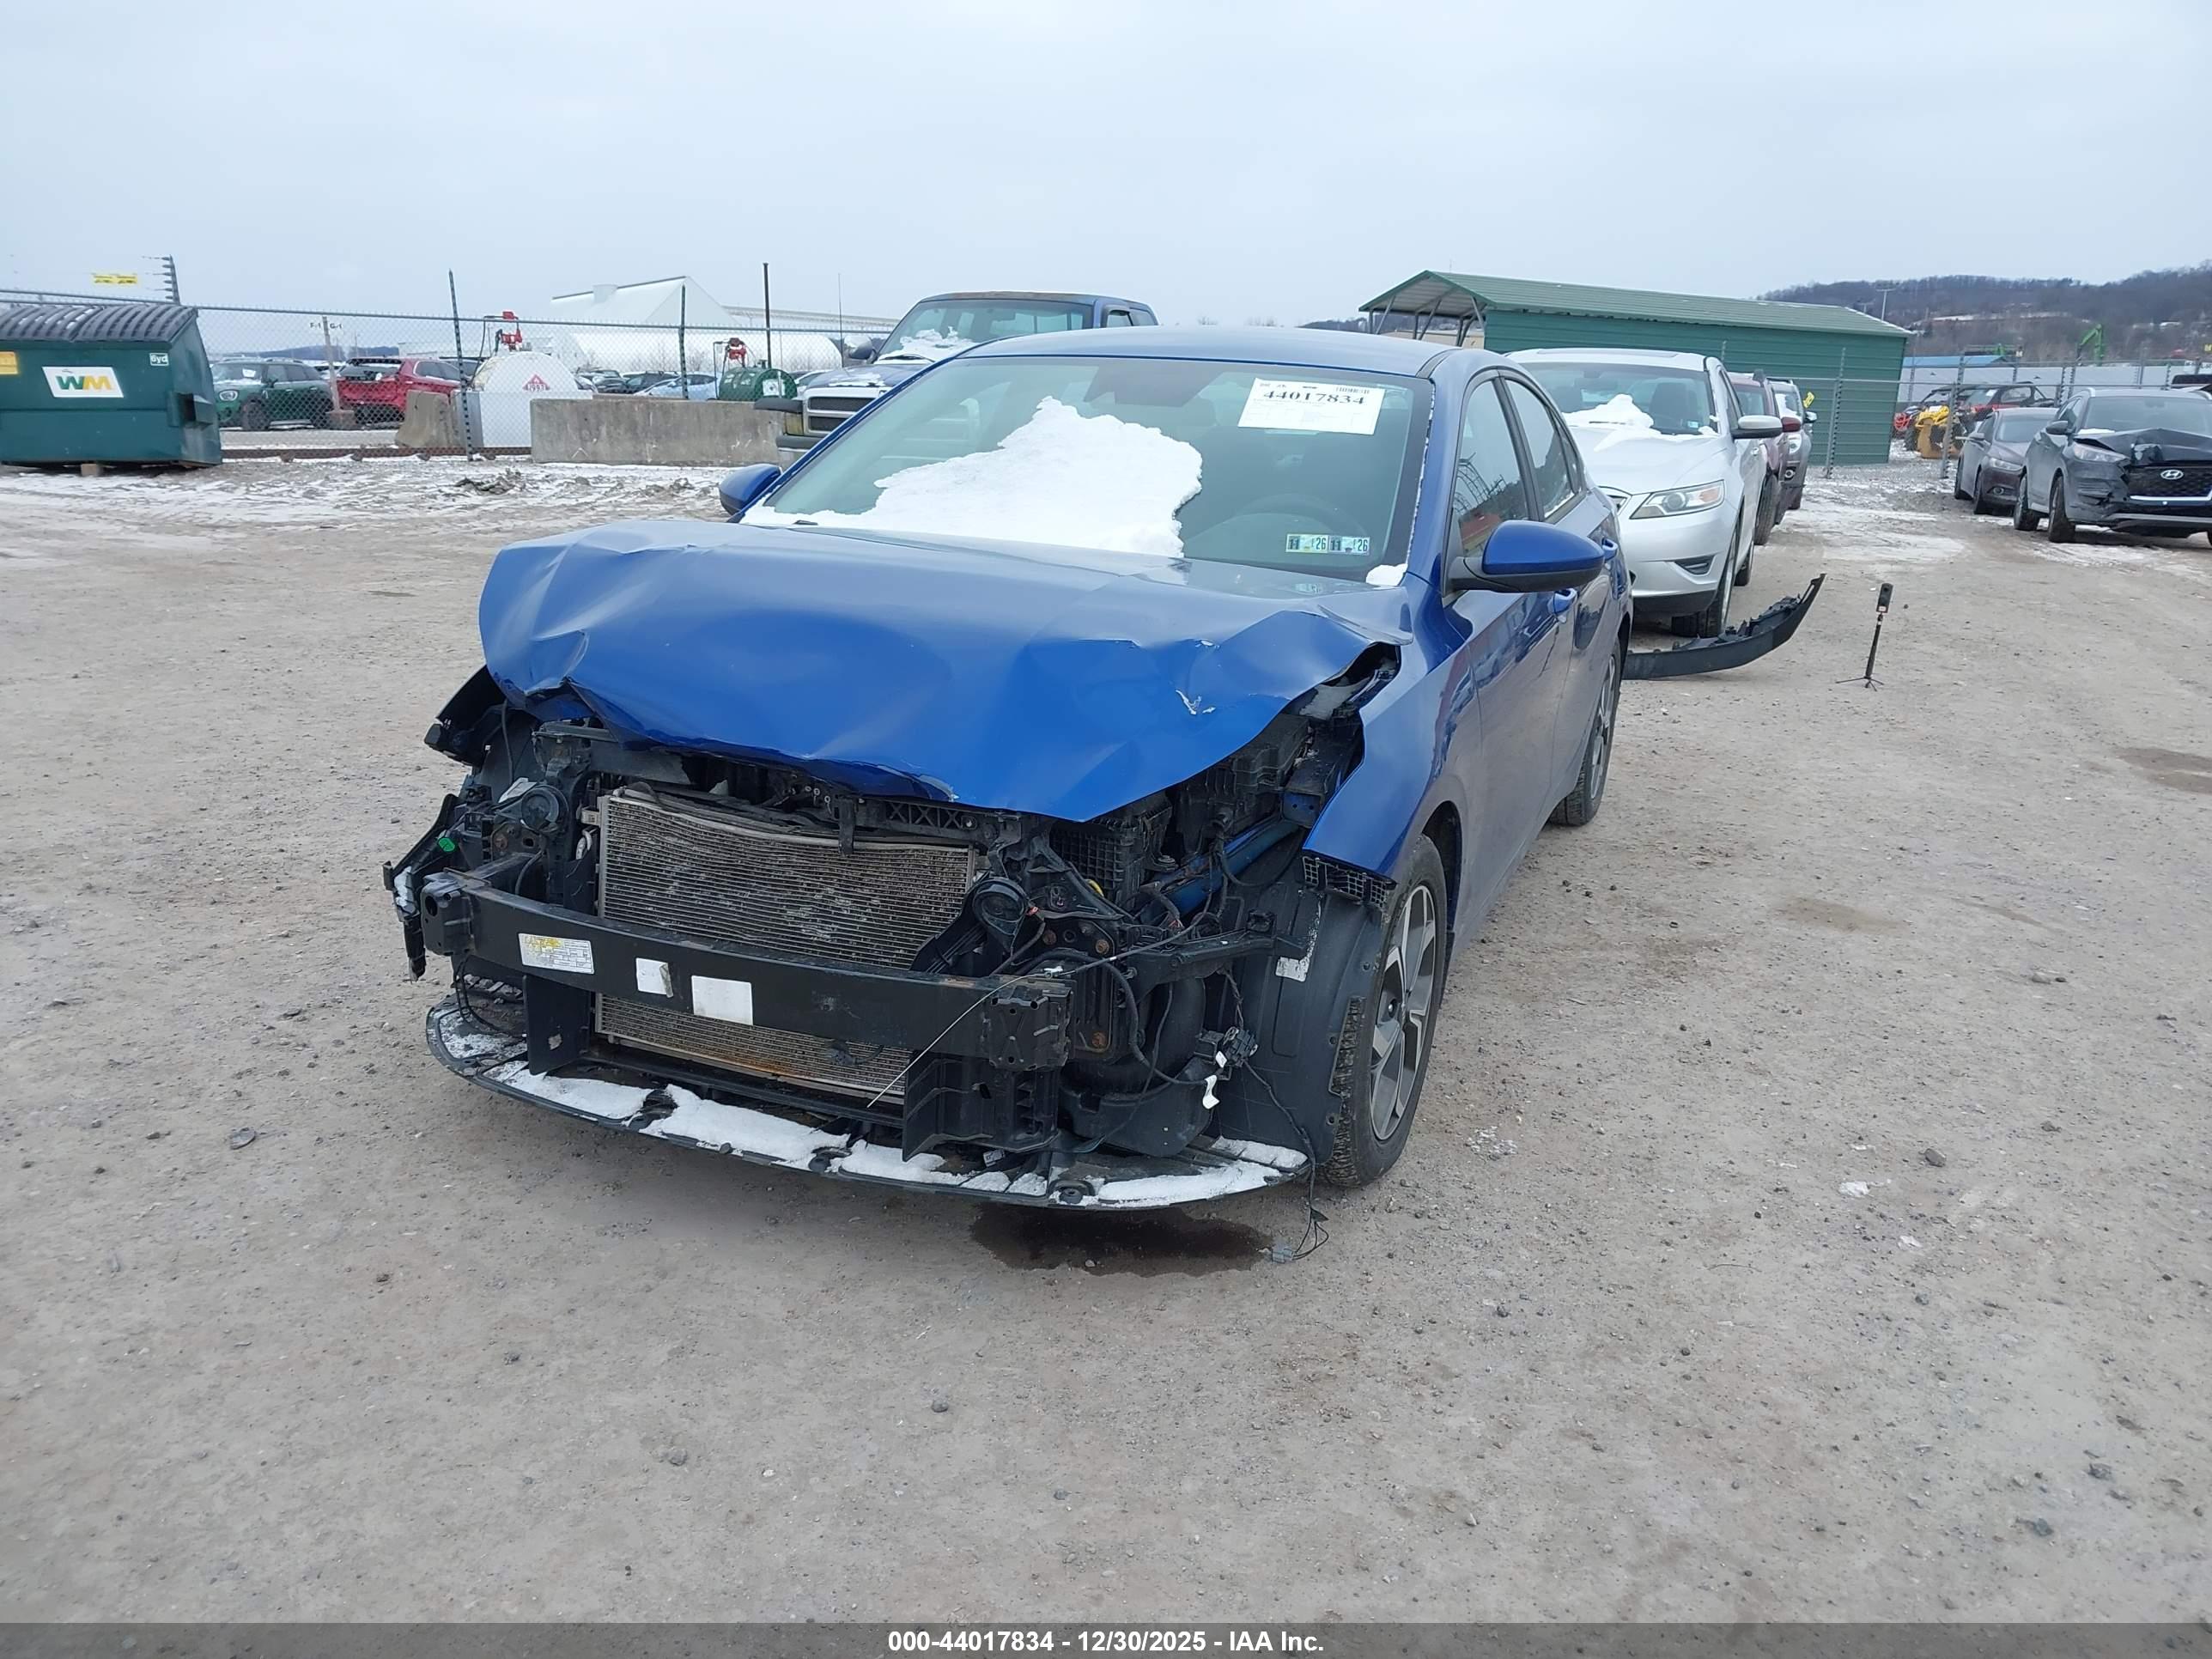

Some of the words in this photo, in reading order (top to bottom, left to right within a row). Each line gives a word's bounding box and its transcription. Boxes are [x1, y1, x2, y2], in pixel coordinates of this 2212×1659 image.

[56, 375, 112, 390] WM
[1263, 390, 1365, 404] 44017834
[1316, 537, 1327, 550] 26
[1357, 538, 1368, 552] 26
